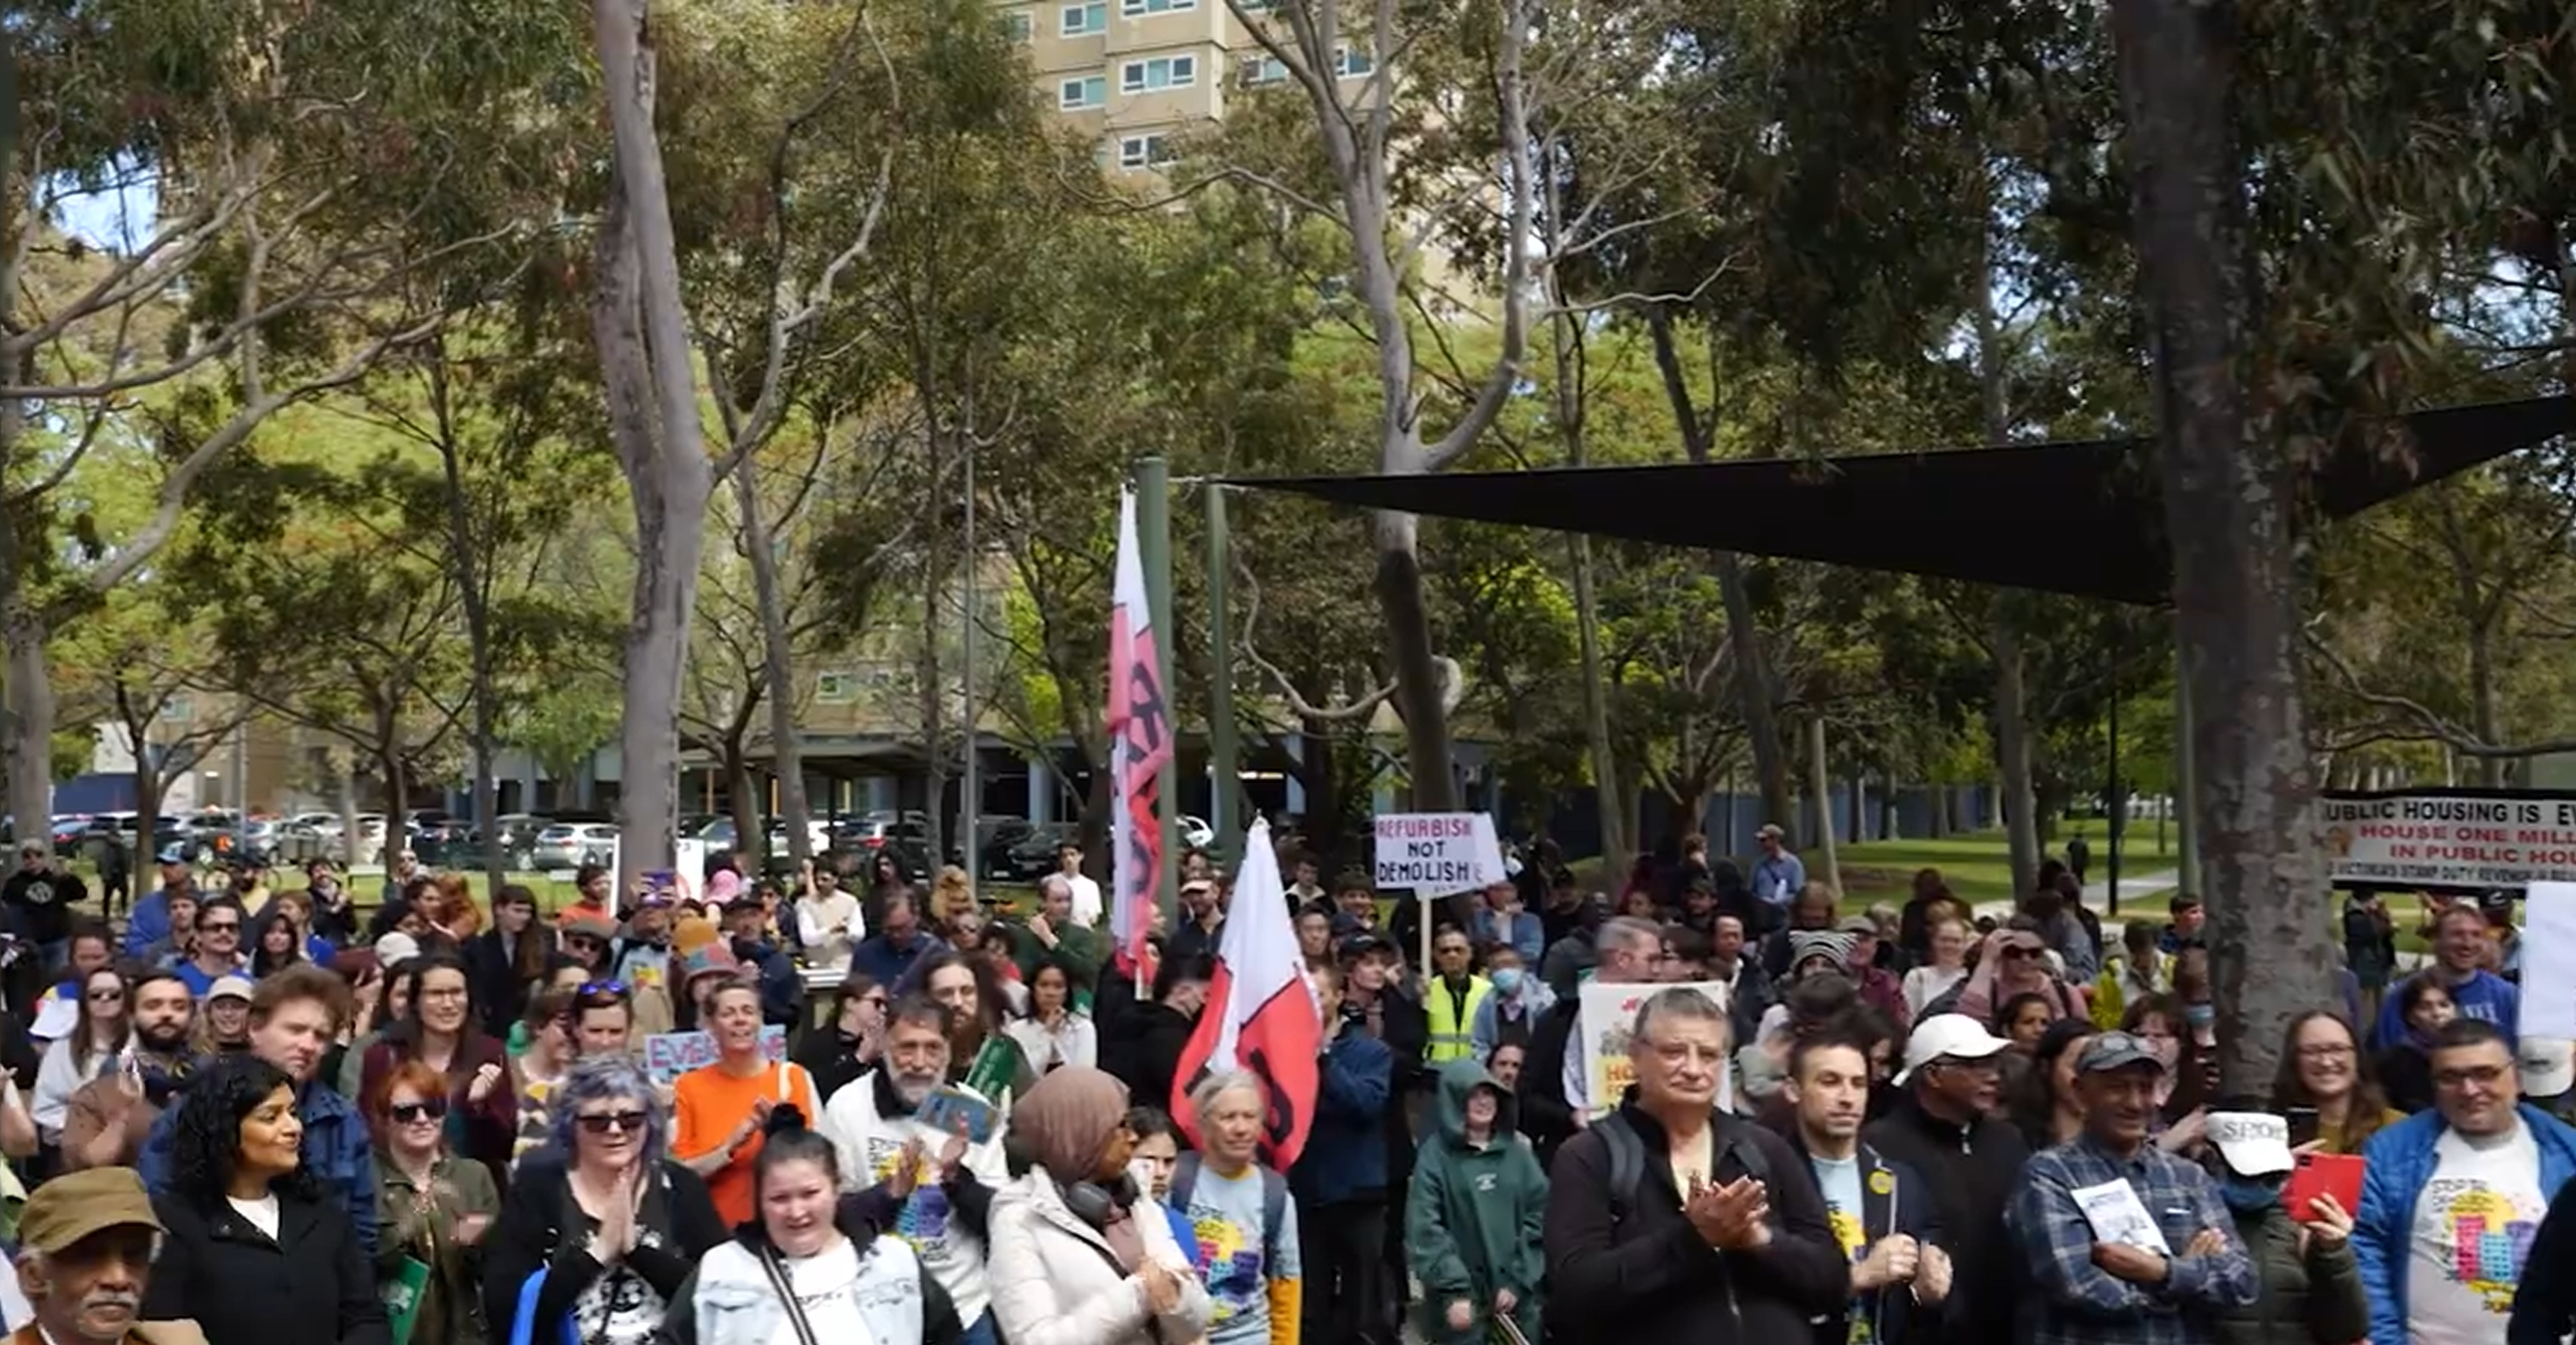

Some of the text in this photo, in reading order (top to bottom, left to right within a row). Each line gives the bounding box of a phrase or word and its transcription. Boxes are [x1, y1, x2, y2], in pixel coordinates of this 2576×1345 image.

[2326, 801, 2396, 822] UBLIC
[2404, 801, 2508, 823] HOUSING
[2518, 804, 2541, 824] IS
[1377, 818, 1472, 838] REFURBISH
[2360, 824, 2447, 841] HOUSE
[2456, 827, 2508, 843] ONE
[1408, 840, 1445, 858] NOT
[2390, 844, 2415, 858] IN
[2426, 845, 2519, 863] PUBLIC
[1379, 862, 1469, 882] DEMOLISH
